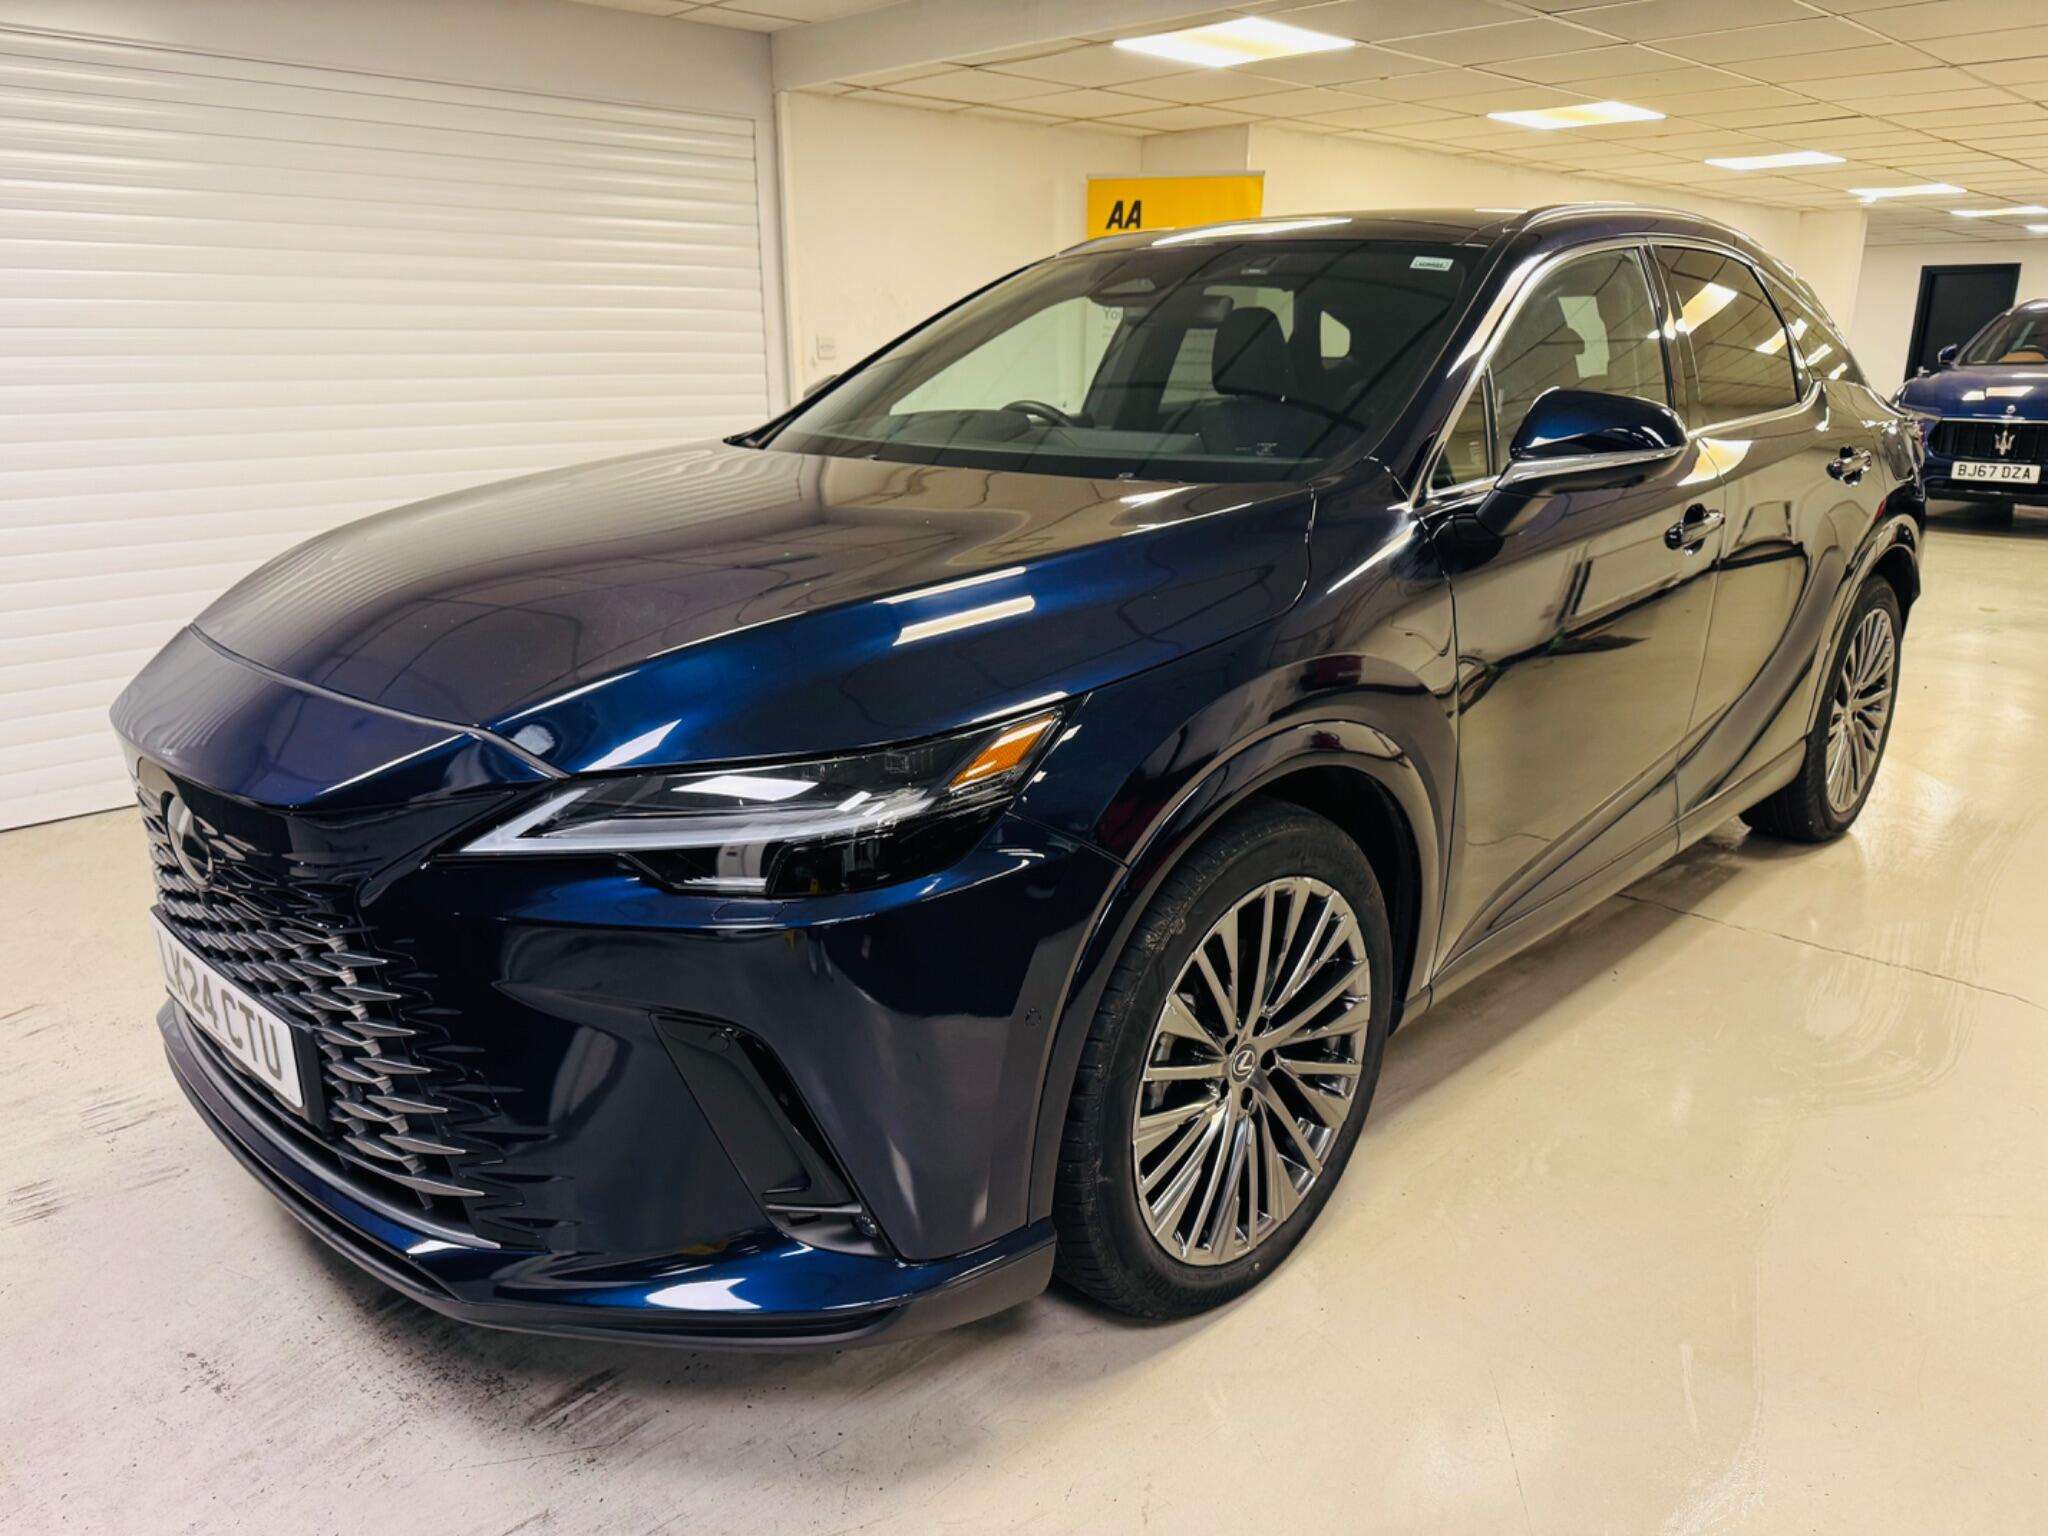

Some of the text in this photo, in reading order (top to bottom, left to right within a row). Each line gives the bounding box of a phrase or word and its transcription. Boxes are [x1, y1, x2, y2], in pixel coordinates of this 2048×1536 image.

[1106, 200, 1142, 229] AA
[1957, 464, 2031, 480] BJ67 DZA
[220, 988, 282, 1081] CTU
